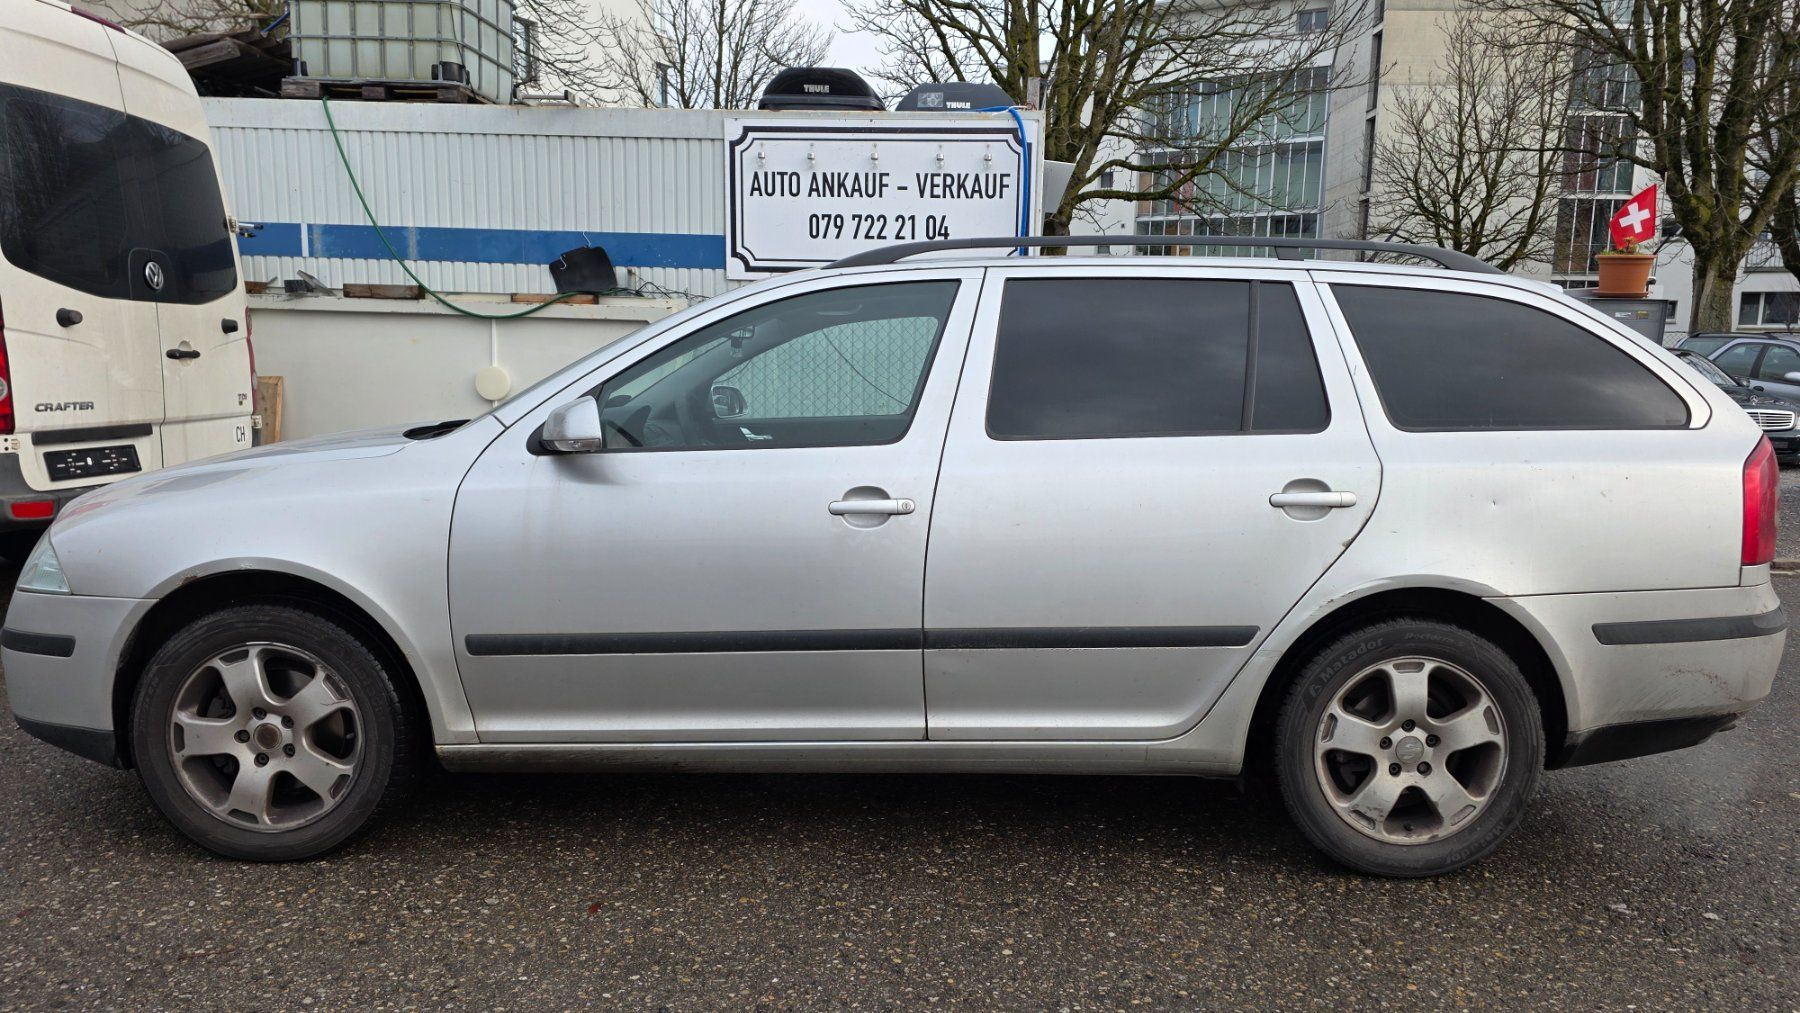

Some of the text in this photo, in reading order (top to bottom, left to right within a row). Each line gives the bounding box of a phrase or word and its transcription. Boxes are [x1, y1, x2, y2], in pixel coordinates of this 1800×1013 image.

[803, 84, 830, 93] THULE
[946, 101, 971, 109] THULE
[749, 171, 801, 198] AUTO
[807, 171, 890, 199] ANKAUF
[916, 172, 1011, 199] VERKAUF
[808, 213, 950, 240] 079 722 21 04
[34, 401, 95, 413] CRAFTER
[235, 426, 246, 443] CH
[1319, 637, 1385, 683] Matador
